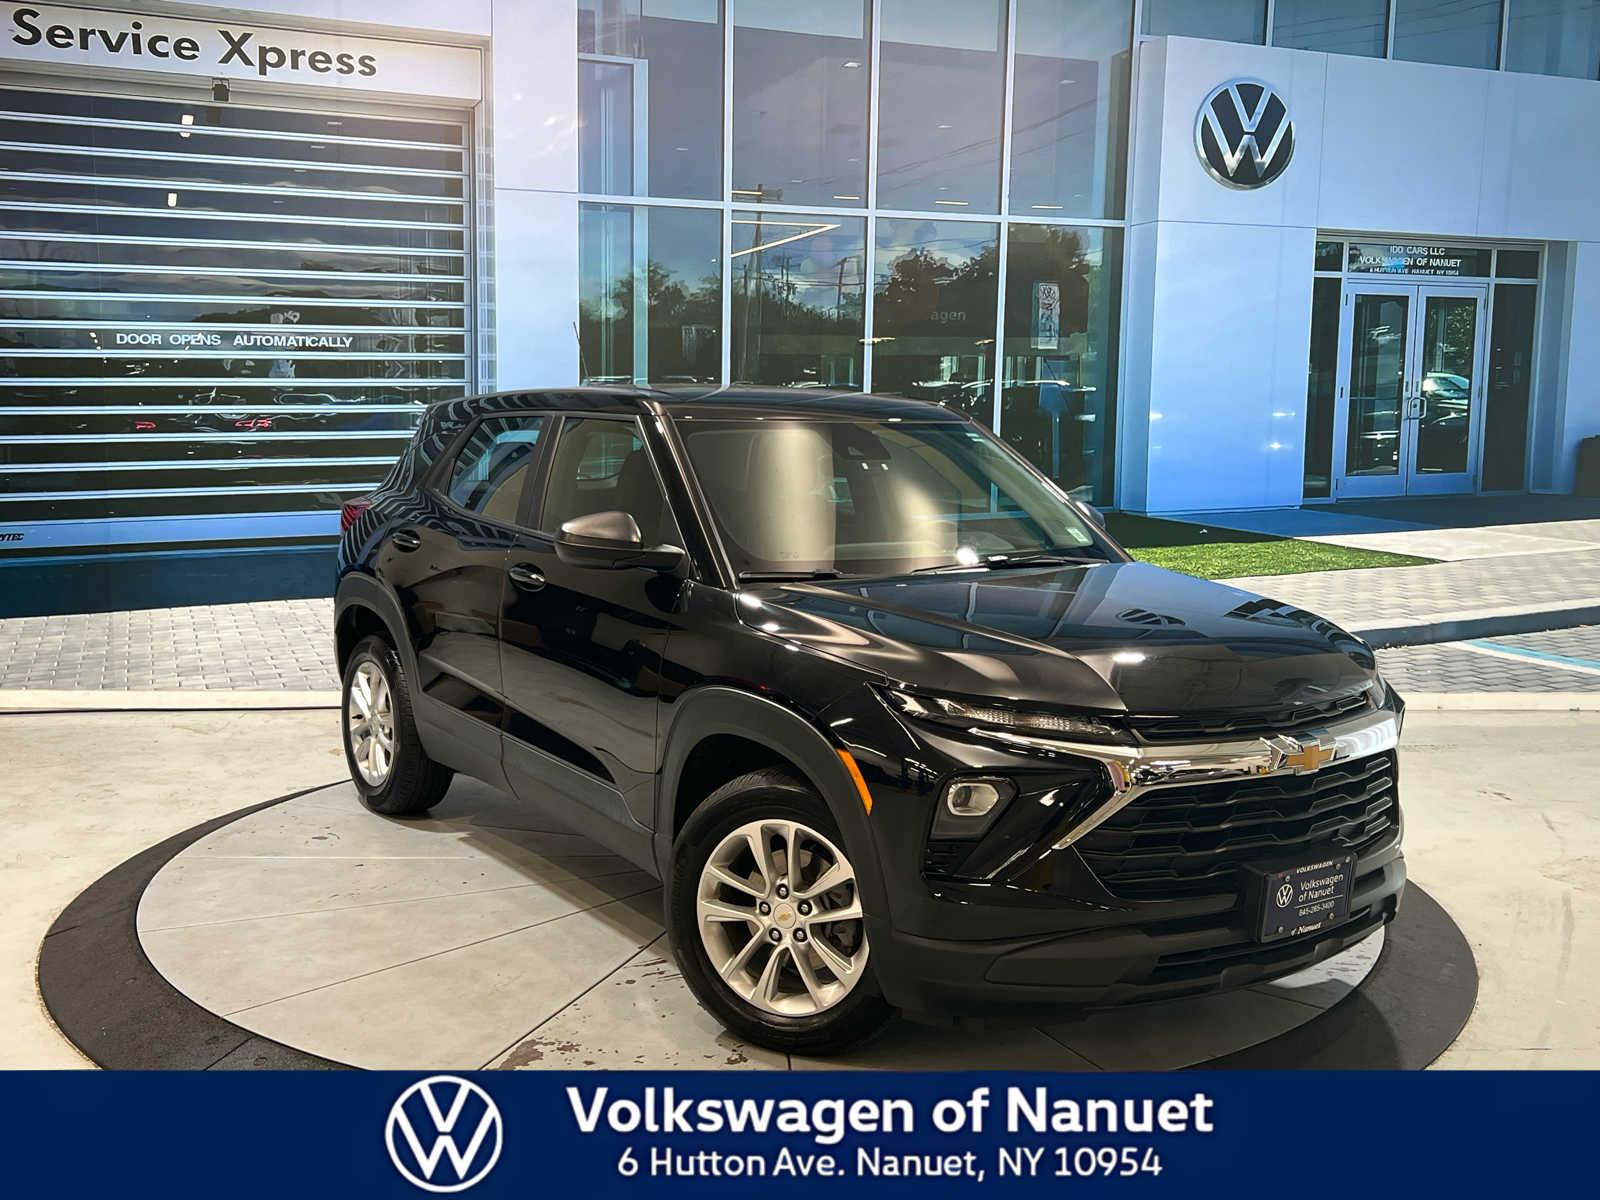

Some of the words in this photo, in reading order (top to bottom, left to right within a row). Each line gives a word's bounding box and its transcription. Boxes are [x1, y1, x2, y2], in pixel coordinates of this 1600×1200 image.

[12, 8, 200, 61] Service
[217, 29, 378, 77] Xpress
[1406, 246, 1429, 256] CARS
[1429, 247, 1446, 256] LLC
[1359, 255, 1413, 266] VOLKEN
[1416, 257, 1428, 267] OF
[1429, 258, 1462, 268] NANUET
[116, 333, 162, 345] DOOR
[169, 333, 222, 346] OPENS
[233, 335, 353, 349] AUTOMATICALLY
[1300, 874, 1344, 891] Volkswagen
[1298, 890, 1308, 903] of
[1308, 886, 1334, 900] Nanuet
